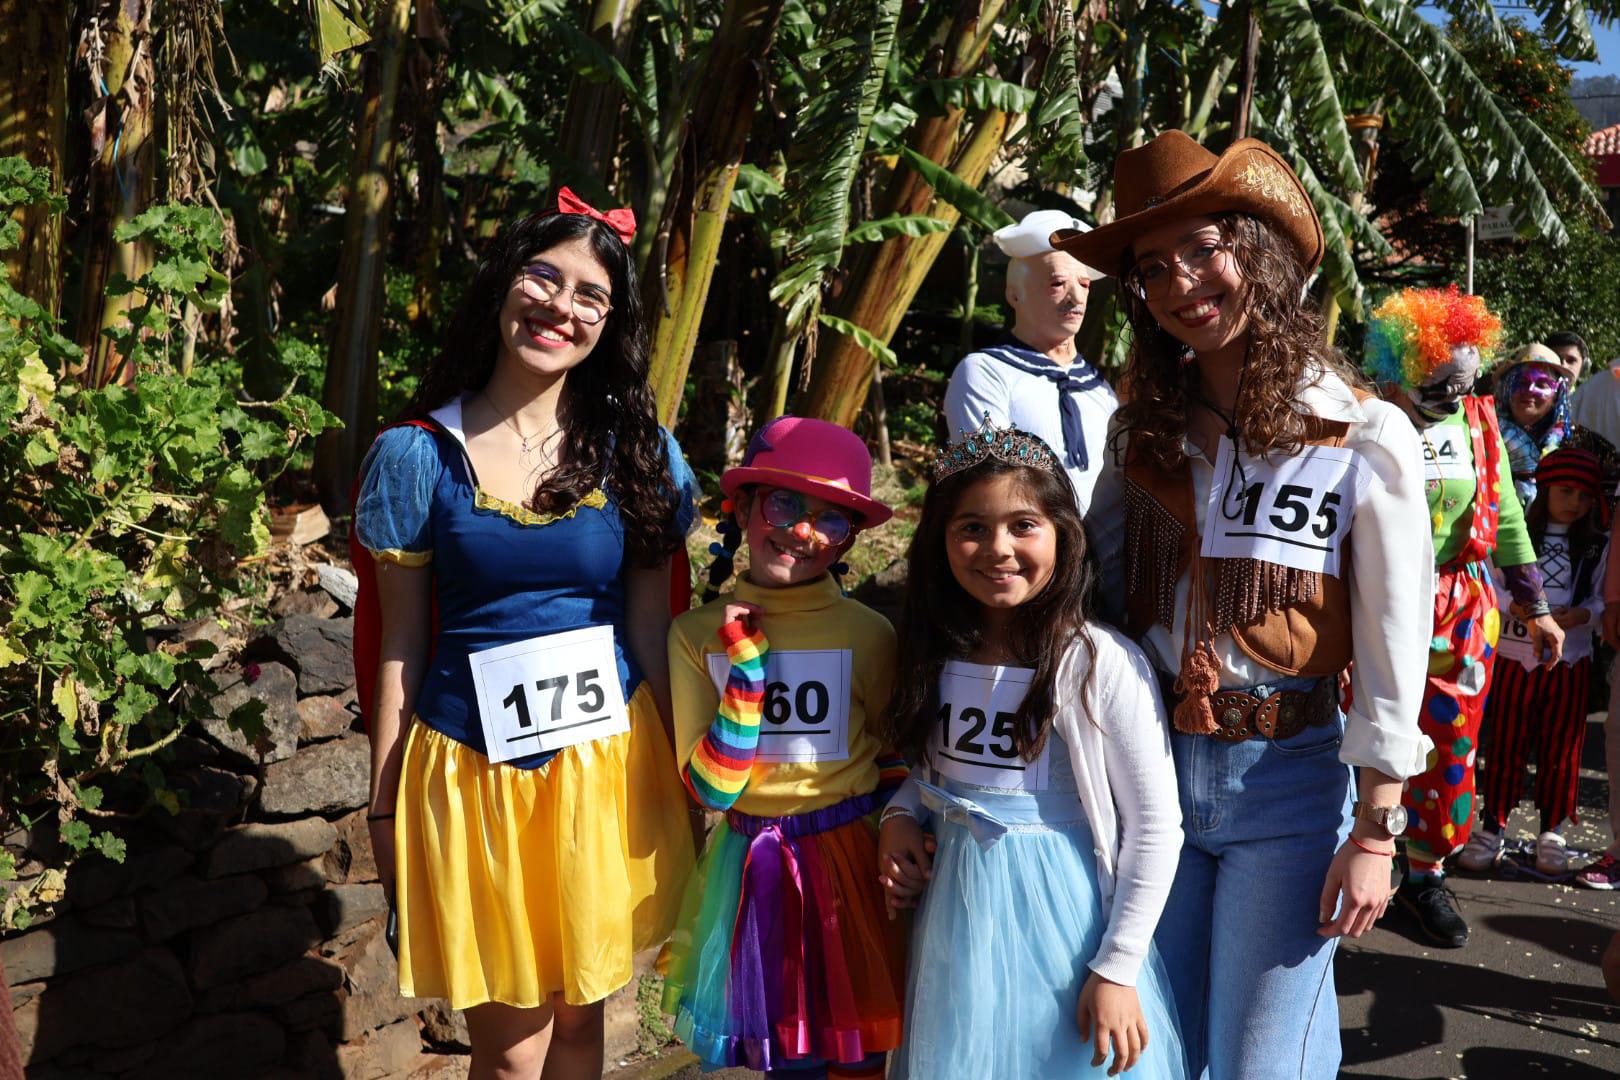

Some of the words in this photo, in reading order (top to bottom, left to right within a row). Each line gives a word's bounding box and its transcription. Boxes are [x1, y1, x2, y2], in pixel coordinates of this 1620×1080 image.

[1235, 482, 1341, 539] 155
[503, 669, 605, 728] 175
[763, 681, 829, 725] 60
[938, 703, 1021, 758] 125
